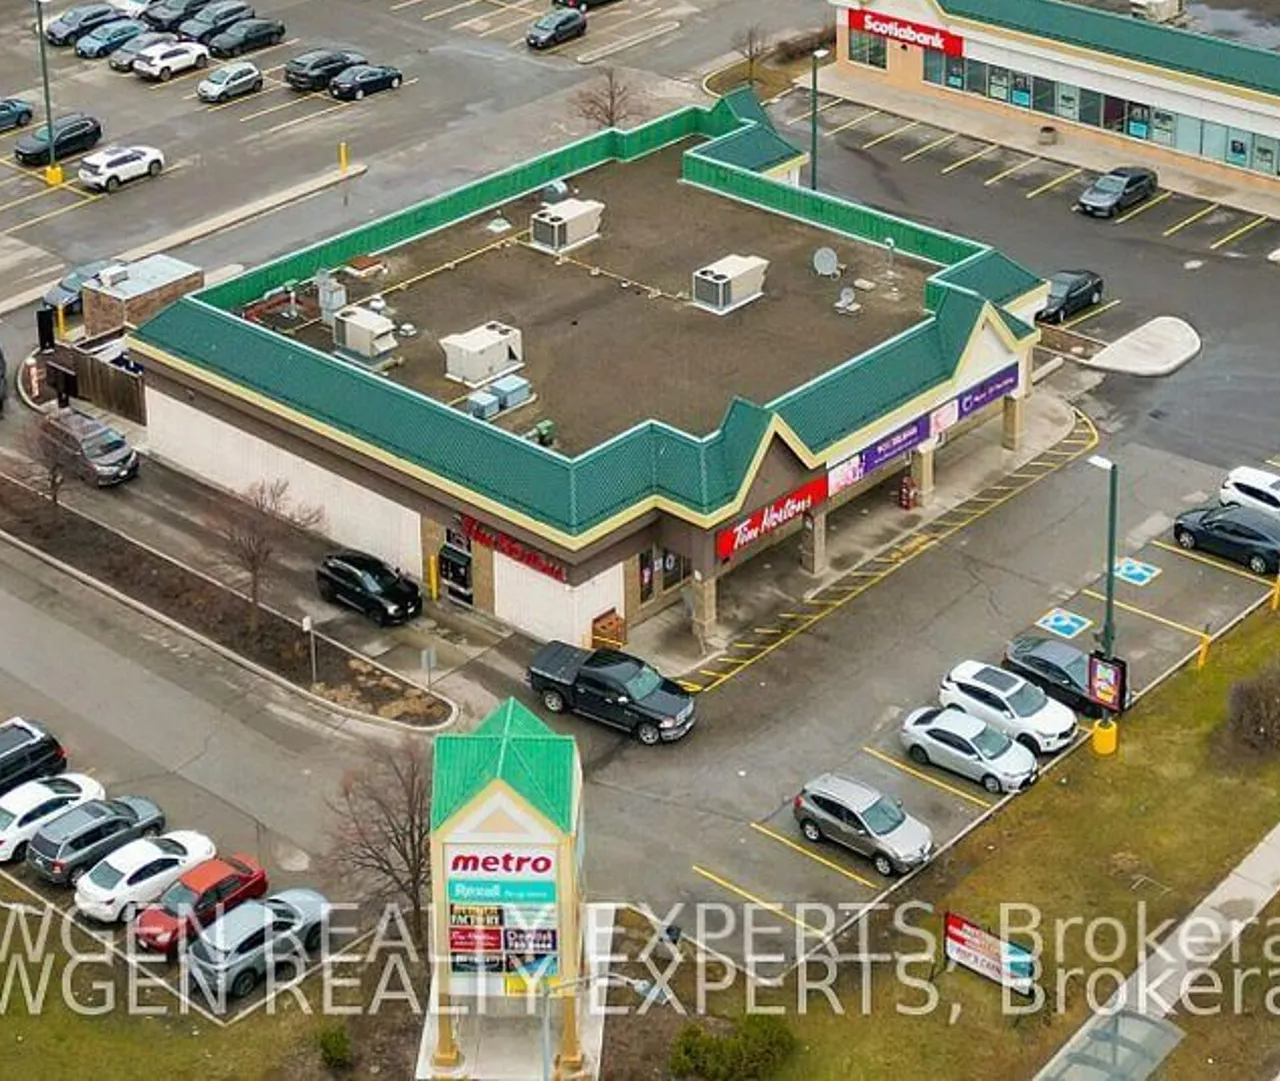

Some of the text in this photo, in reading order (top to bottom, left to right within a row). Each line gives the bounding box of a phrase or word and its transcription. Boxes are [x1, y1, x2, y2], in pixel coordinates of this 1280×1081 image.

[863, 15, 945, 50] Scotiabank
[733, 494, 812, 550] Tim Hortons
[451, 852, 553, 874] metro
